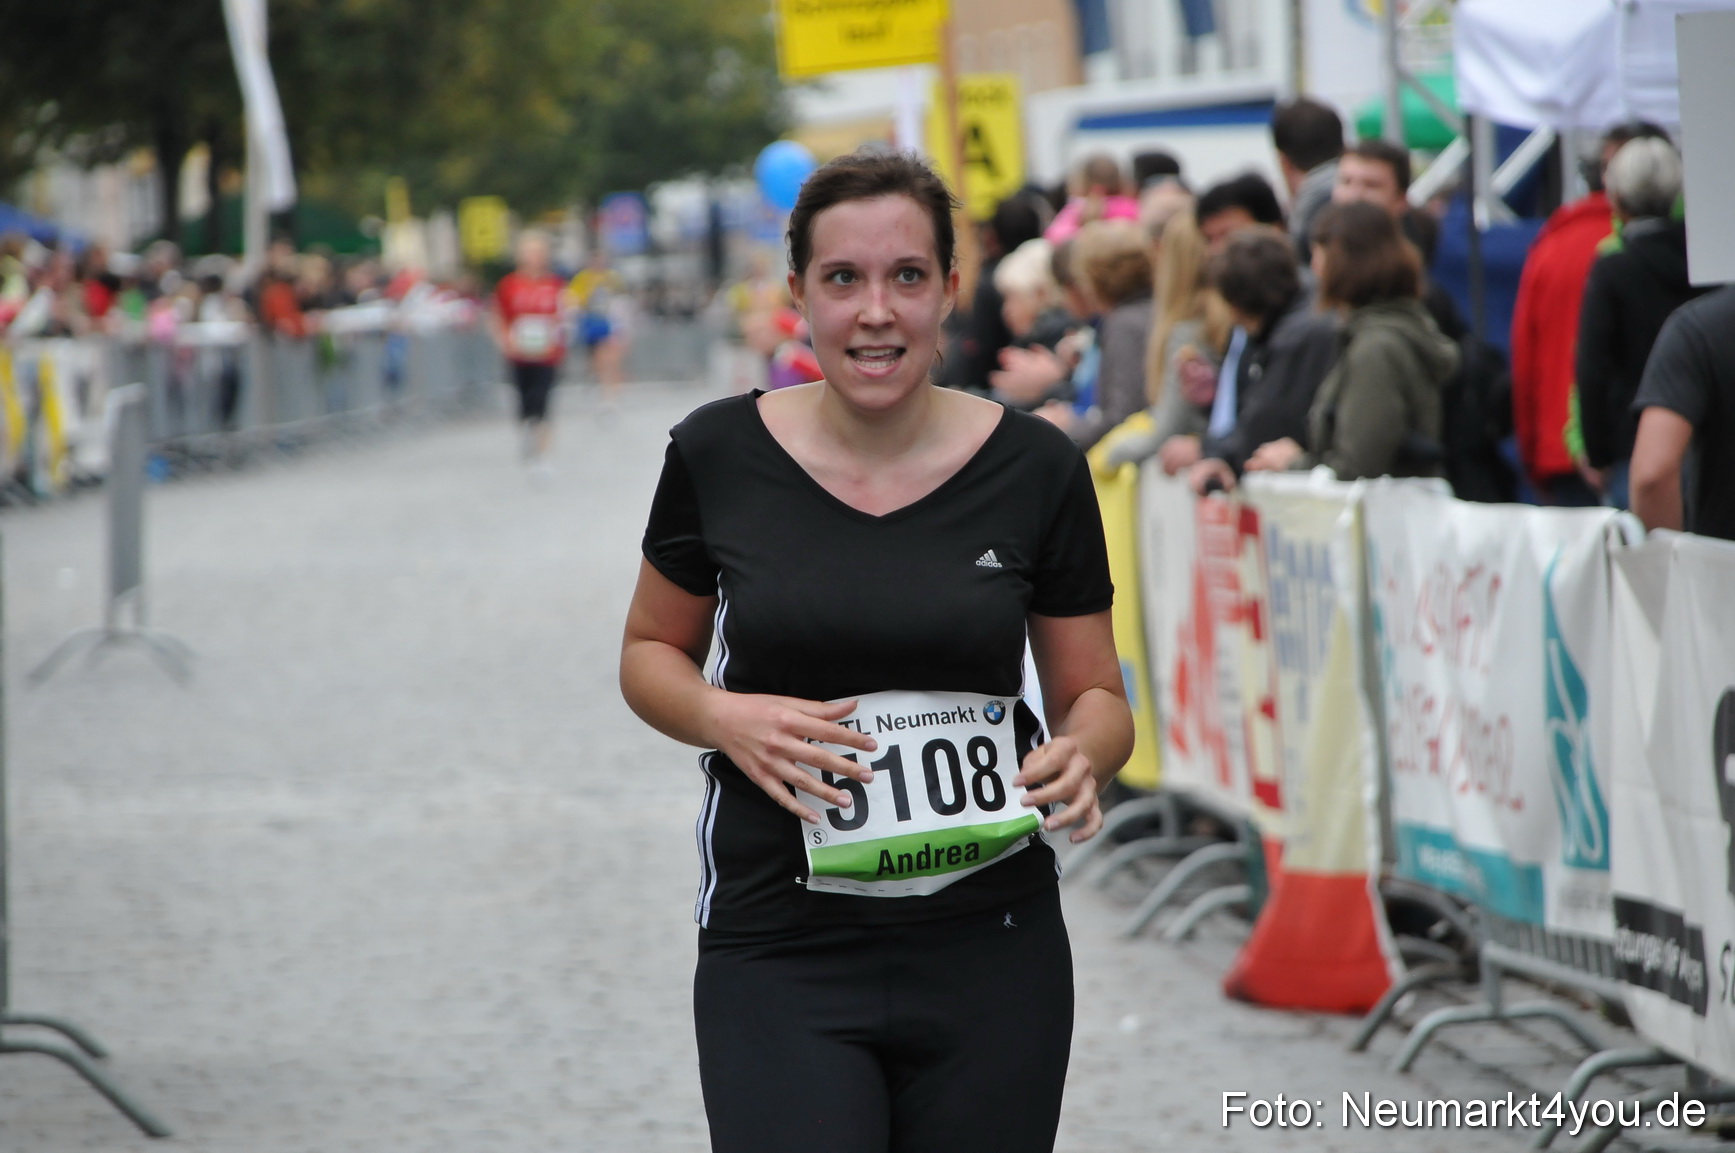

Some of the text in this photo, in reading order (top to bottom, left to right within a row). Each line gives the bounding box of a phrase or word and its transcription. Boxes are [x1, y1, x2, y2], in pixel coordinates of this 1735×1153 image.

[976, 560, 1003, 568] adidas
[876, 705, 977, 734] Neumarkt
[820, 735, 1007, 831] 5108
[812, 831, 823, 845] S
[876, 842, 980, 877] Andrea
